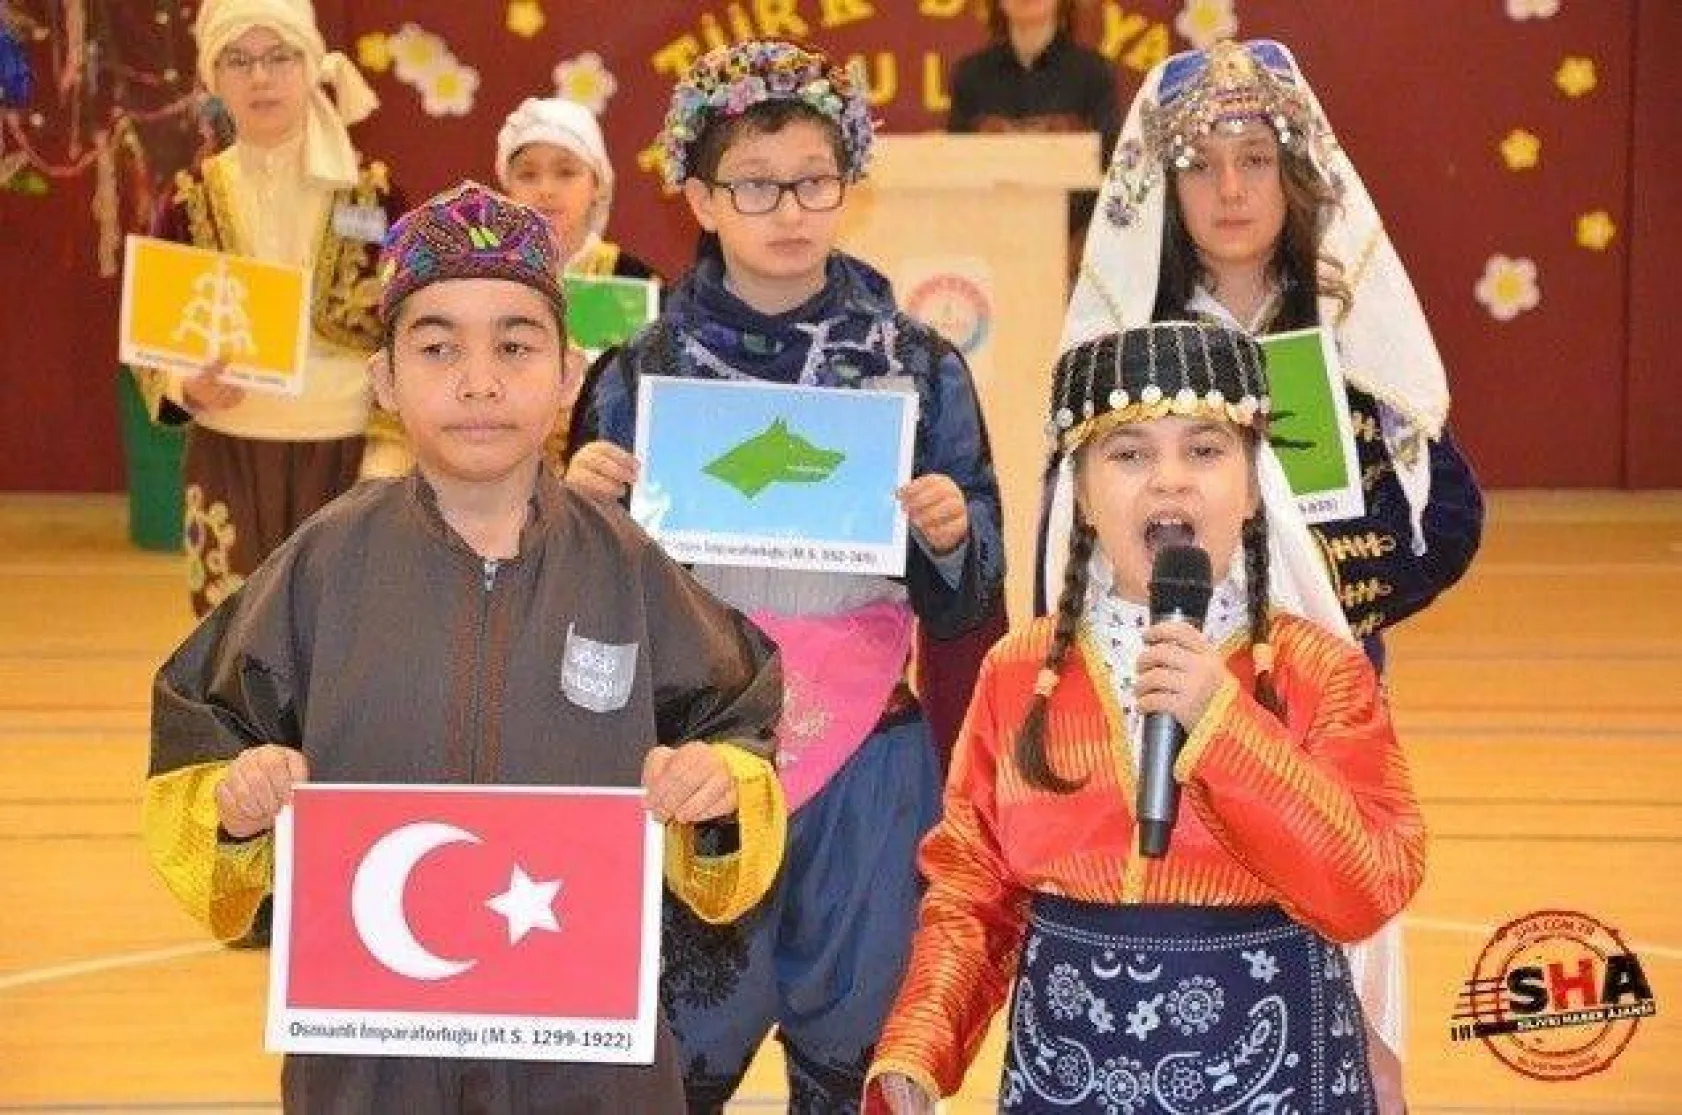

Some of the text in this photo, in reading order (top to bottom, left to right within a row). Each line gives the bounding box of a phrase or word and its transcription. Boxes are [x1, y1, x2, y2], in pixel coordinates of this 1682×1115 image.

[289, 1021, 357, 1039] Osmanlı
[359, 1021, 478, 1047] İmparatorluğu
[532, 1028, 633, 1052] 1299-1922)
